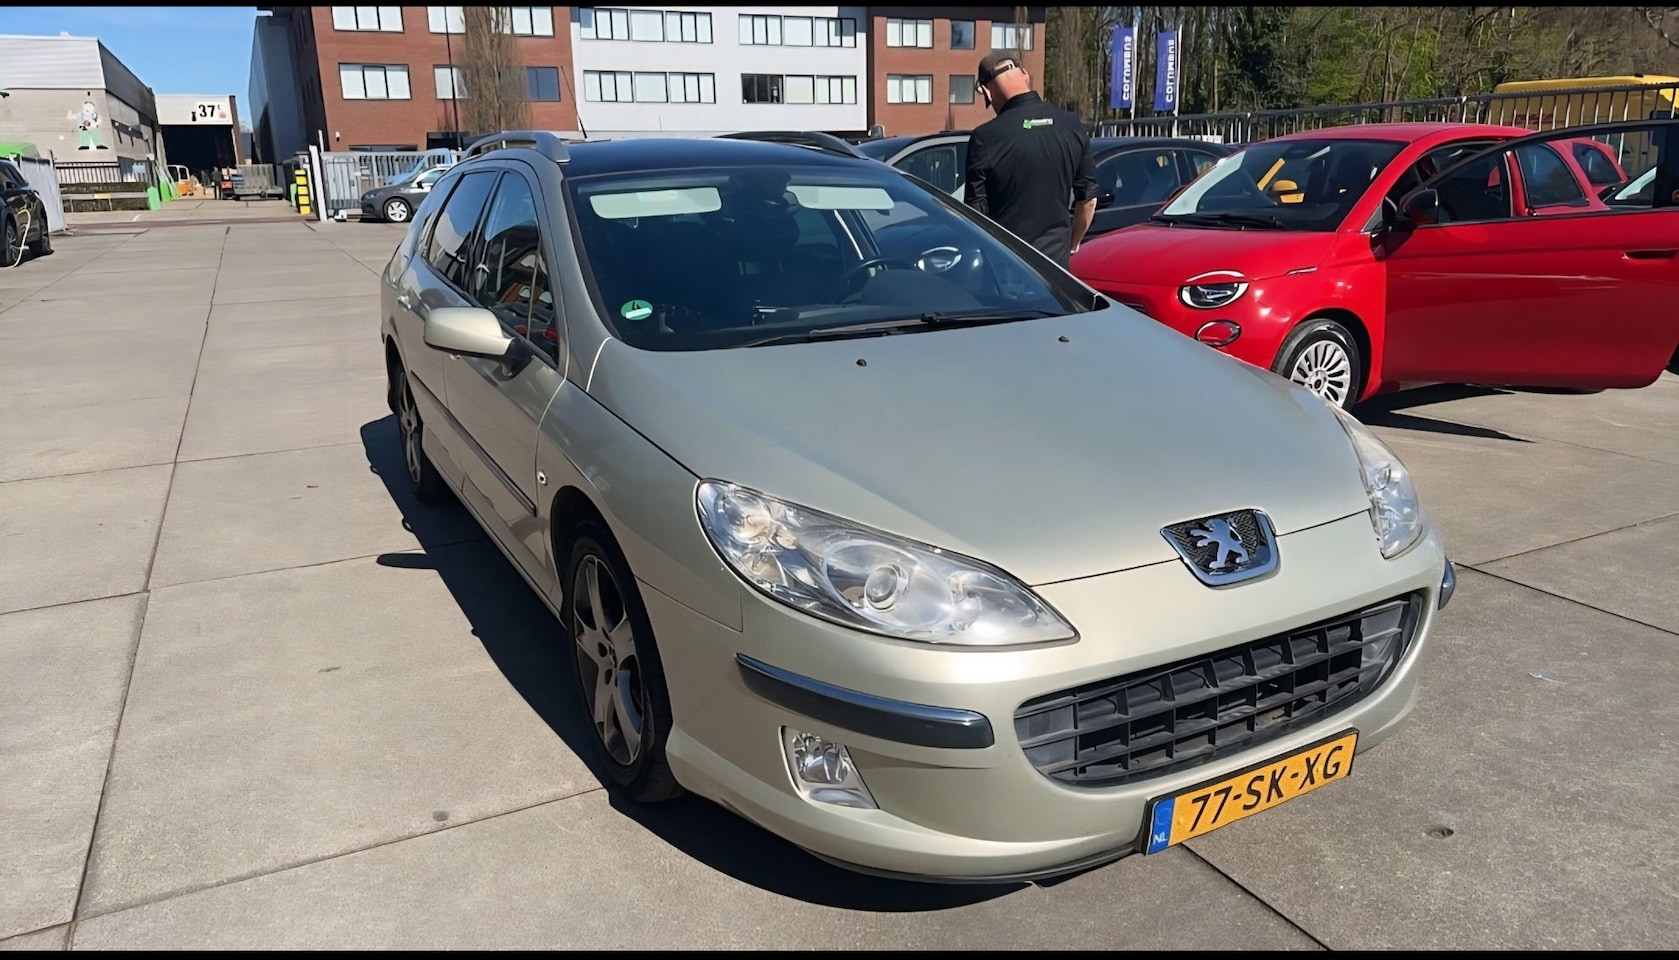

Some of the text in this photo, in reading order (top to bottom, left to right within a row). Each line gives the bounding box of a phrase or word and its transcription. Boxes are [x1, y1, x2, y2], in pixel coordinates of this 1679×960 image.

[198, 104, 215, 118] 37
[1189, 745, 1343, 833] 77-SK-XG
[1153, 831, 1167, 845] NL
